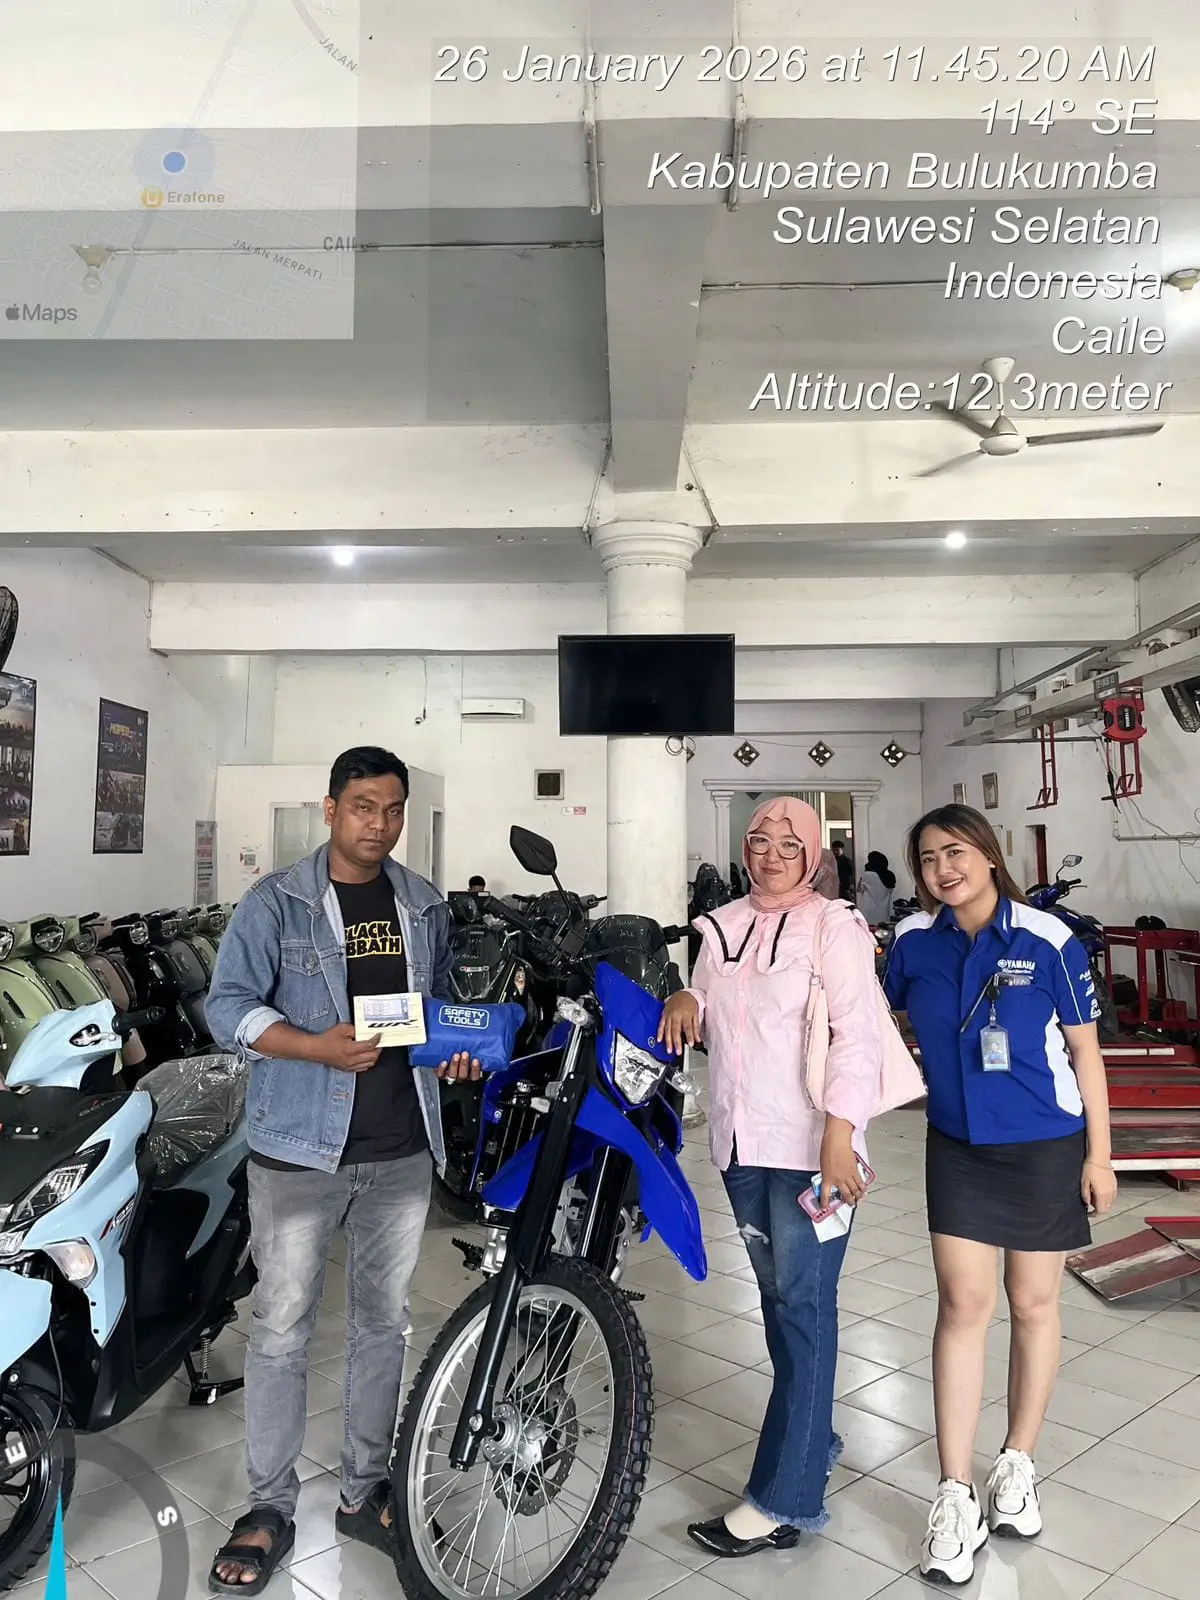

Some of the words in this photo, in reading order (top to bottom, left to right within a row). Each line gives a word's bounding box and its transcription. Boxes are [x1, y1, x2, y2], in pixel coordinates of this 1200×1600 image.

[345, 921, 391, 943] LACK
[346, 935, 402, 958] BBATH
[1007, 959, 1036, 971] YAMAHA
[445, 1008, 485, 1019] SAFETY
[448, 1015, 481, 1026] TOOLS
